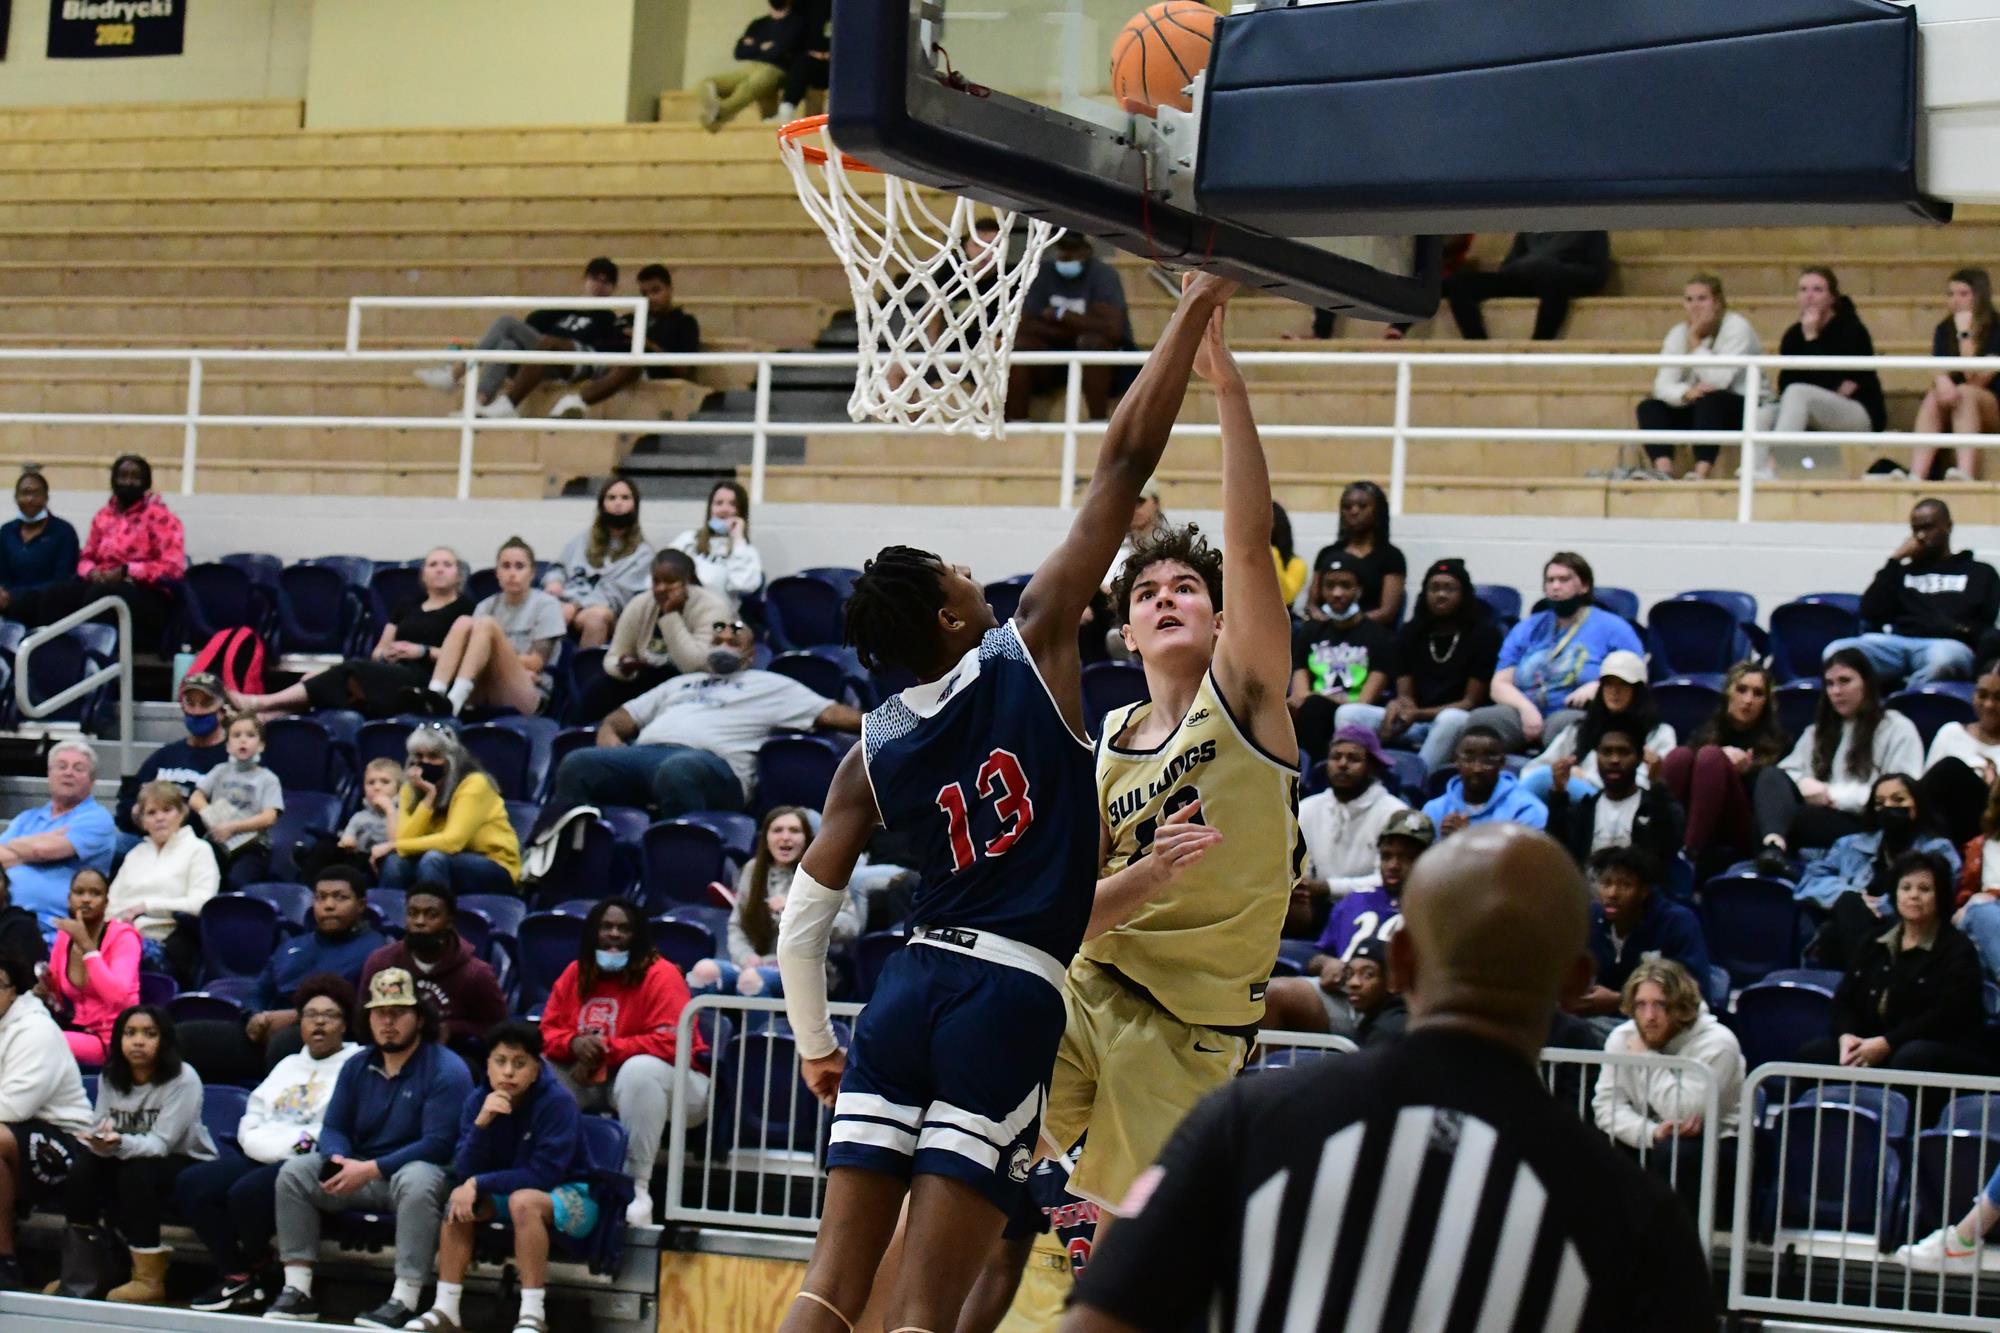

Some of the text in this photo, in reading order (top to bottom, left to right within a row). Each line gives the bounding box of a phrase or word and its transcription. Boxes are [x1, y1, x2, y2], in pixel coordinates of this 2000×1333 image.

[62, 0, 173, 22] Biedrycki
[1188, 708, 1210, 725] SAC
[1108, 739, 1217, 828] BULLDOGS
[935, 747, 1034, 876] 13
